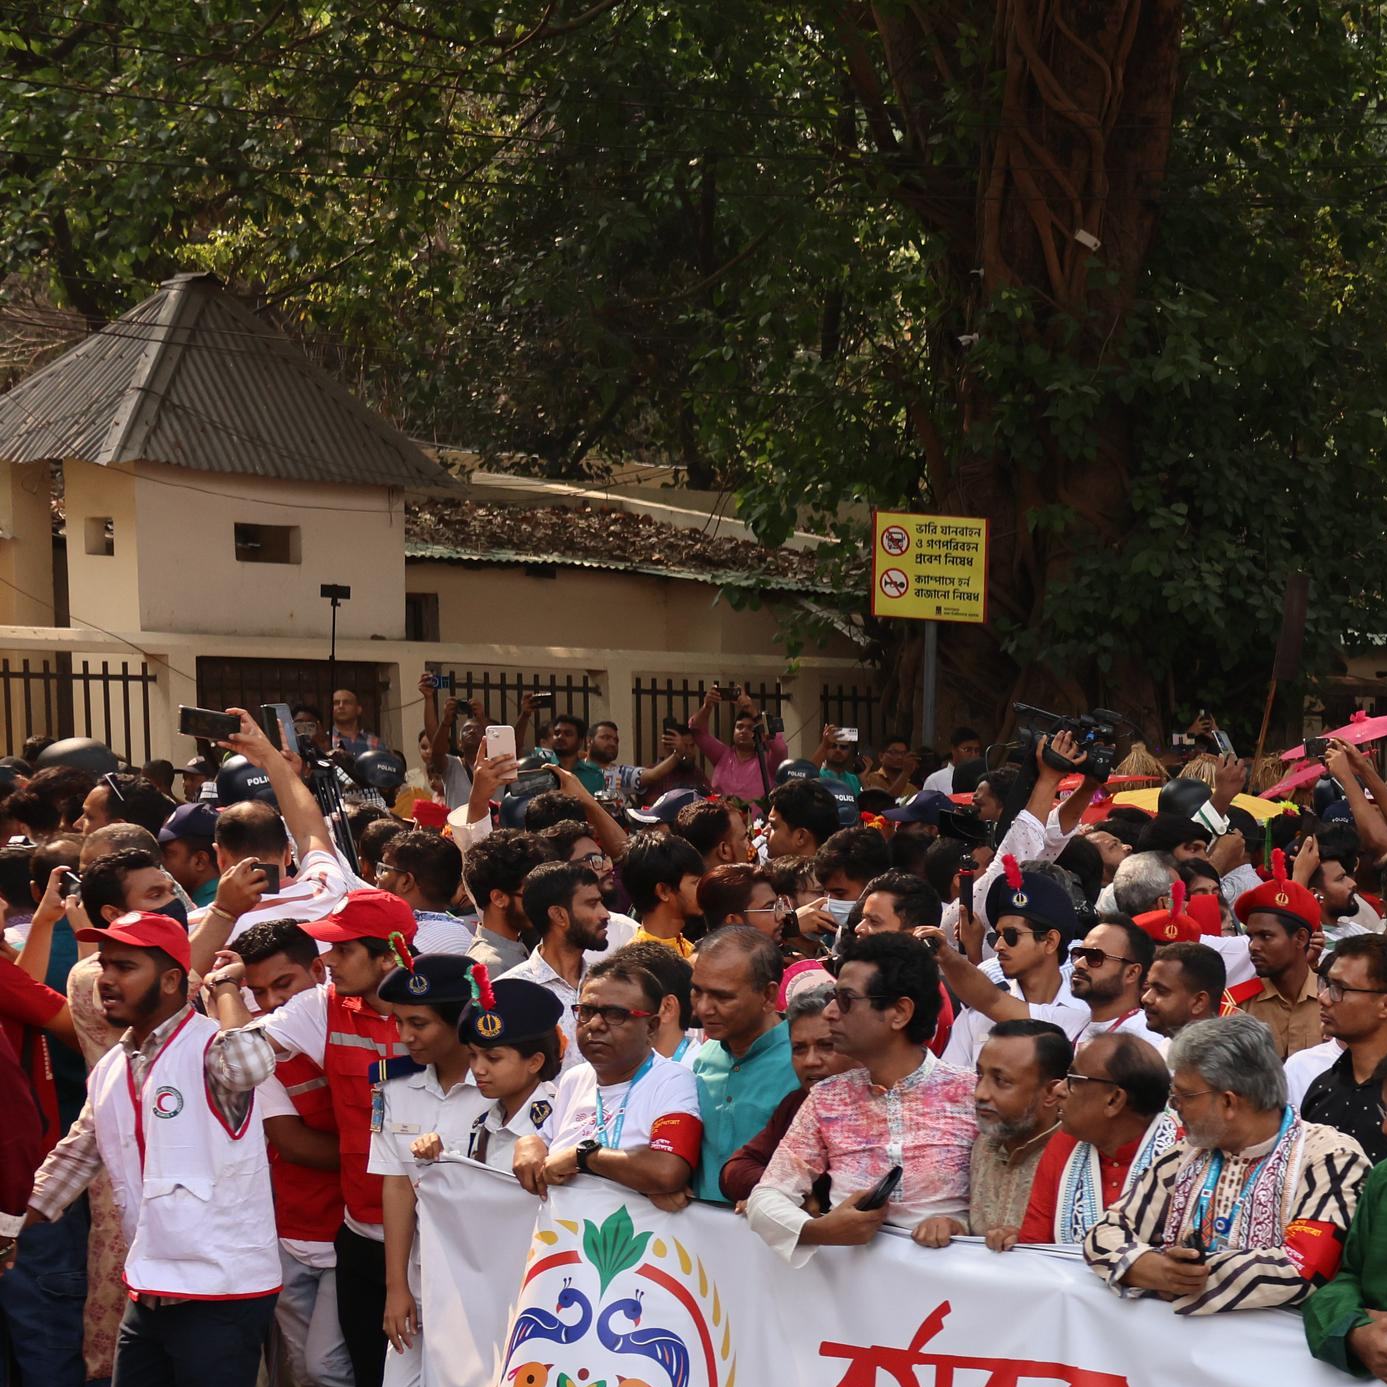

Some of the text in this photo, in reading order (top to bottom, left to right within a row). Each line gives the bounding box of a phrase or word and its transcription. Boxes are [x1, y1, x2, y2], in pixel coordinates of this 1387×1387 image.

[916, 522, 981, 537] ভারি যানবাহন
[916, 538, 979, 552] ও গণপরিবহন
[915, 553, 974, 567] প্রবেশ নিষেধ
[914, 588, 980, 602] বাজানো নিষেধ
[247, 776, 271, 786] POLI
[787, 770, 806, 778] POLICE
